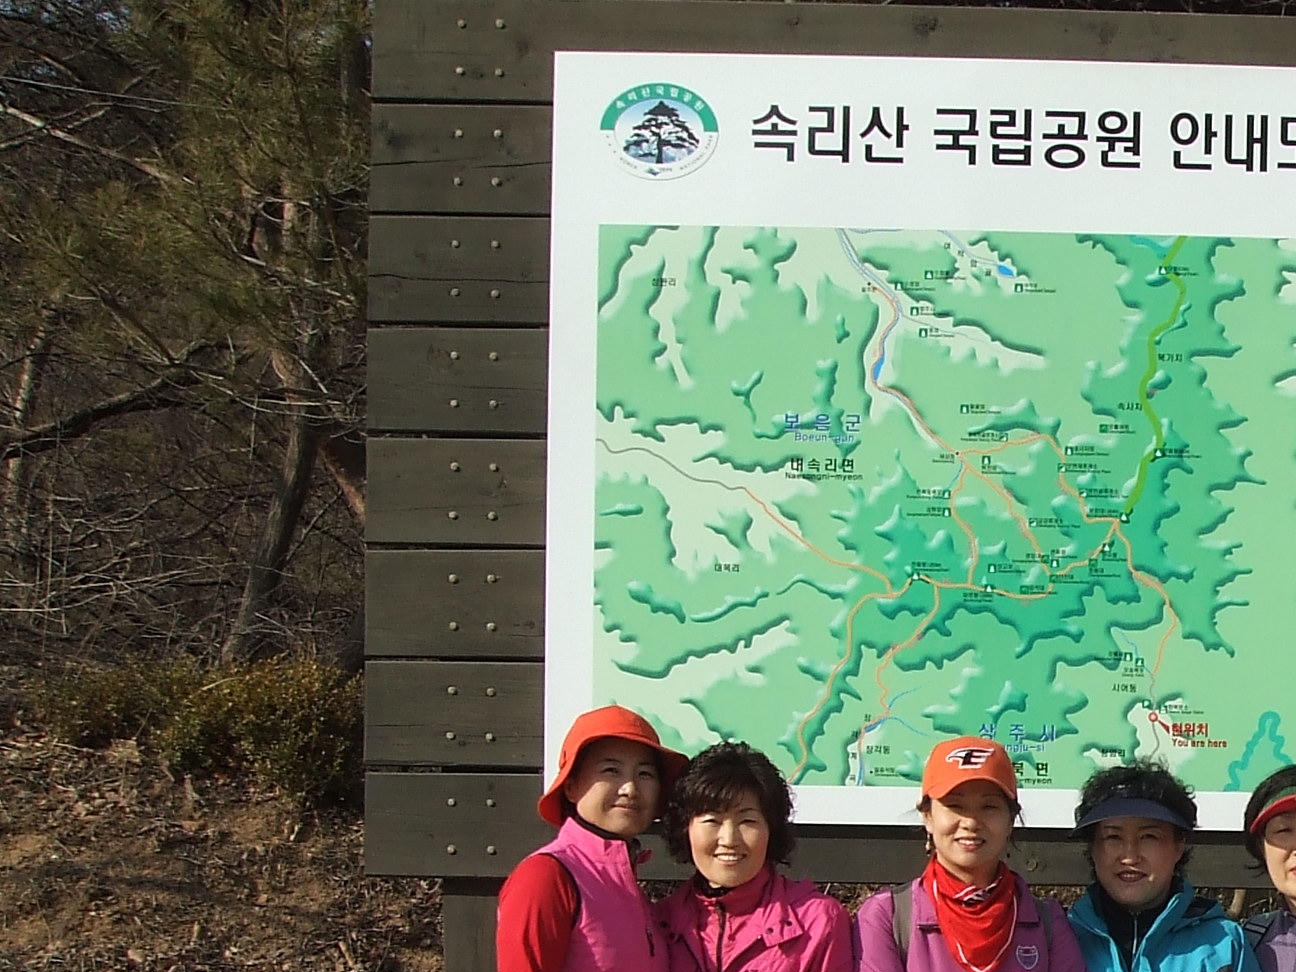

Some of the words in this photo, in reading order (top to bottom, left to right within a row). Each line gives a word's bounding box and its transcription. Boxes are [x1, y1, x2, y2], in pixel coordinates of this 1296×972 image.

[752, 105, 909, 163] 속리산
[934, 109, 1140, 168] 국립공원
[790, 458, 856, 472] 내속리면
[1172, 723, 1208, 737] 현위치
[1172, 739, 1188, 748] You
[1208, 740, 1227, 748] here
